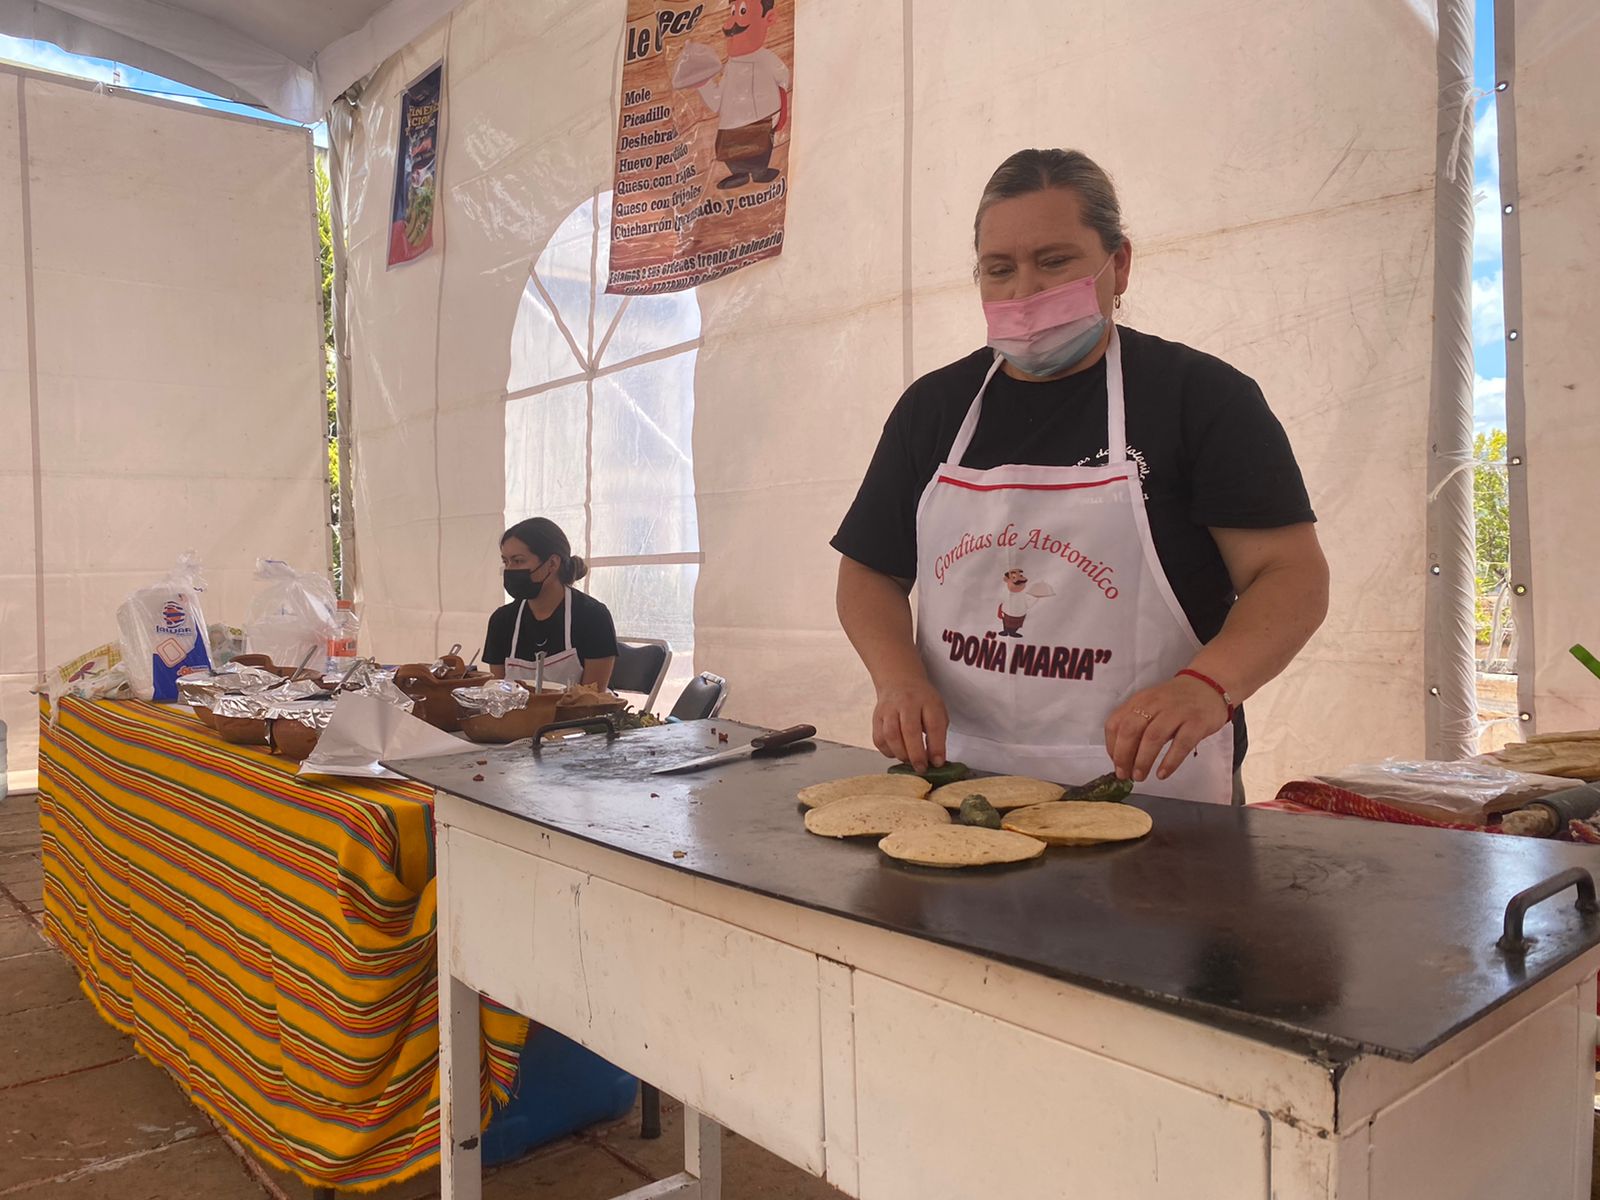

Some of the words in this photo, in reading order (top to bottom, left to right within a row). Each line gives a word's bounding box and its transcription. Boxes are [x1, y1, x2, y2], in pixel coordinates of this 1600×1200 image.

[627, 25, 651, 61] Le
[624, 88, 651, 106] Mole
[623, 105, 670, 128] Picadillo
[619, 156, 652, 173] Huevo
[617, 178, 653, 196] Queso
[653, 174, 672, 190] con
[614, 216, 672, 241] Chicharrón
[726, 197, 736, 215] y
[739, 177, 786, 209] cuerito)
[616, 200, 648, 218] Queso
[650, 197, 670, 211] con
[609, 269, 641, 286] Estamos
[697, 250, 728, 270] frente
[729, 247, 740, 263] al
[934, 532, 993, 586] Gorditas
[997, 523, 1018, 548] de
[1019, 528, 1120, 600] Atotonilco
